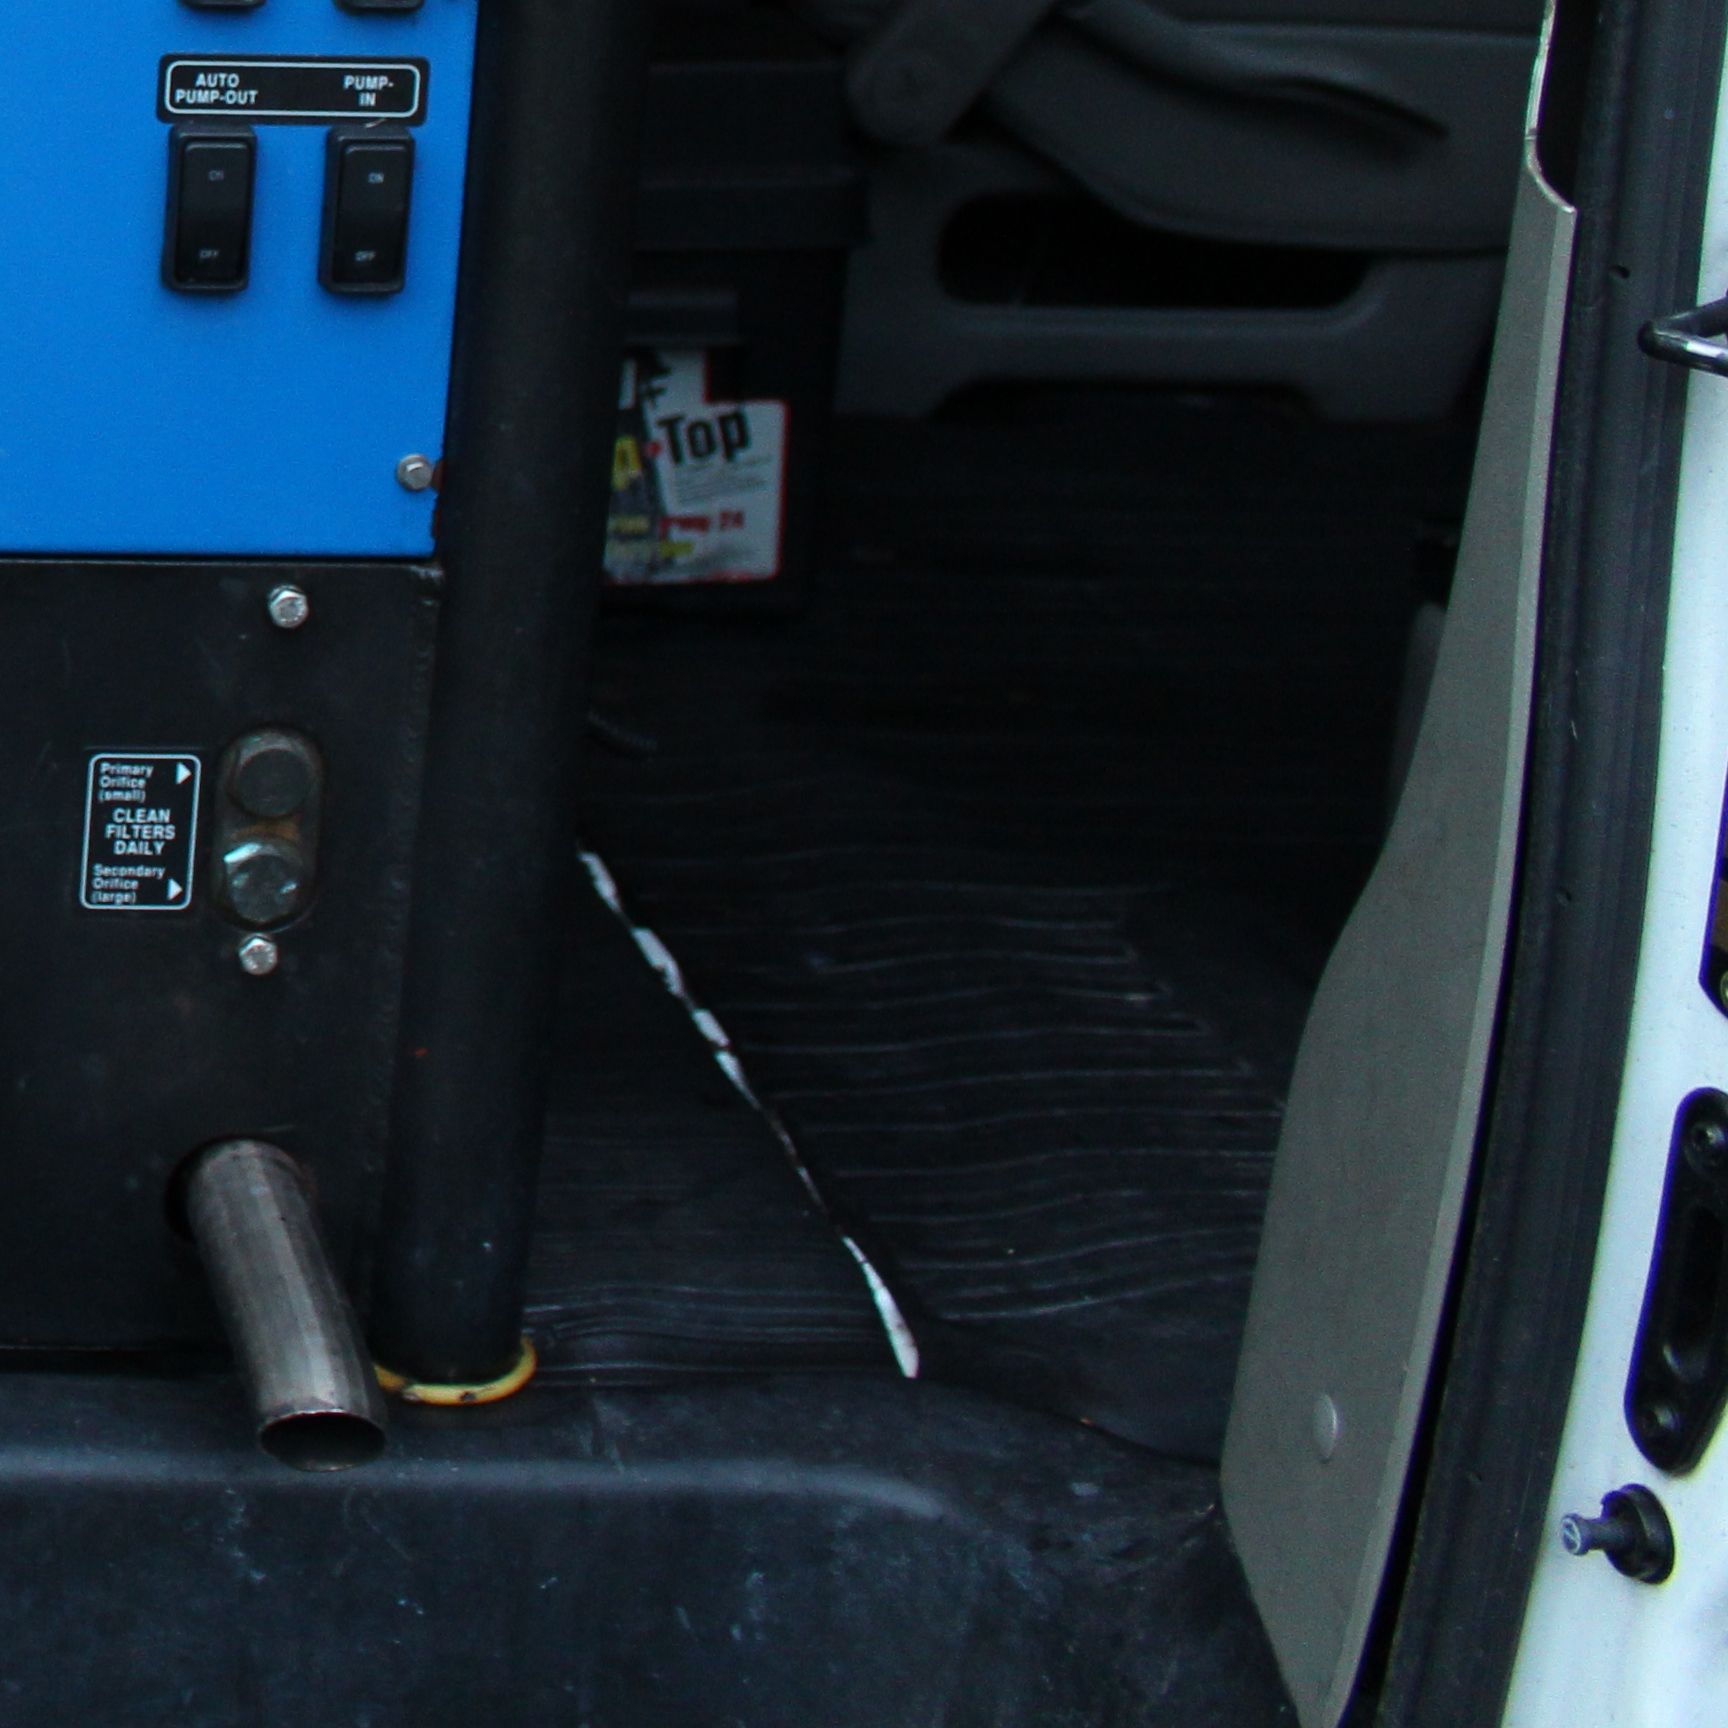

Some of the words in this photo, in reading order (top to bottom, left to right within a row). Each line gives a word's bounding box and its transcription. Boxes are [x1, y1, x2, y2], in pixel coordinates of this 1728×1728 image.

[195, 73, 240, 88] AUTO
[344, 75, 394, 91] PUMP-
[175, 89, 259, 105] PUMP-OUT
[359, 91, 376, 107] IN
[657, 412, 750, 464] Top
[100, 762, 154, 778] Primary
[99, 776, 146, 789] Orifice
[98, 789, 146, 803] (small)
[112, 808, 171, 824] CLEAN
[105, 824, 175, 840] FILTERS
[113, 840, 165, 856] DAILY
[93, 864, 165, 878] Secondary
[93, 878, 139, 890] Orifice
[90, 890, 136, 905] (large)
